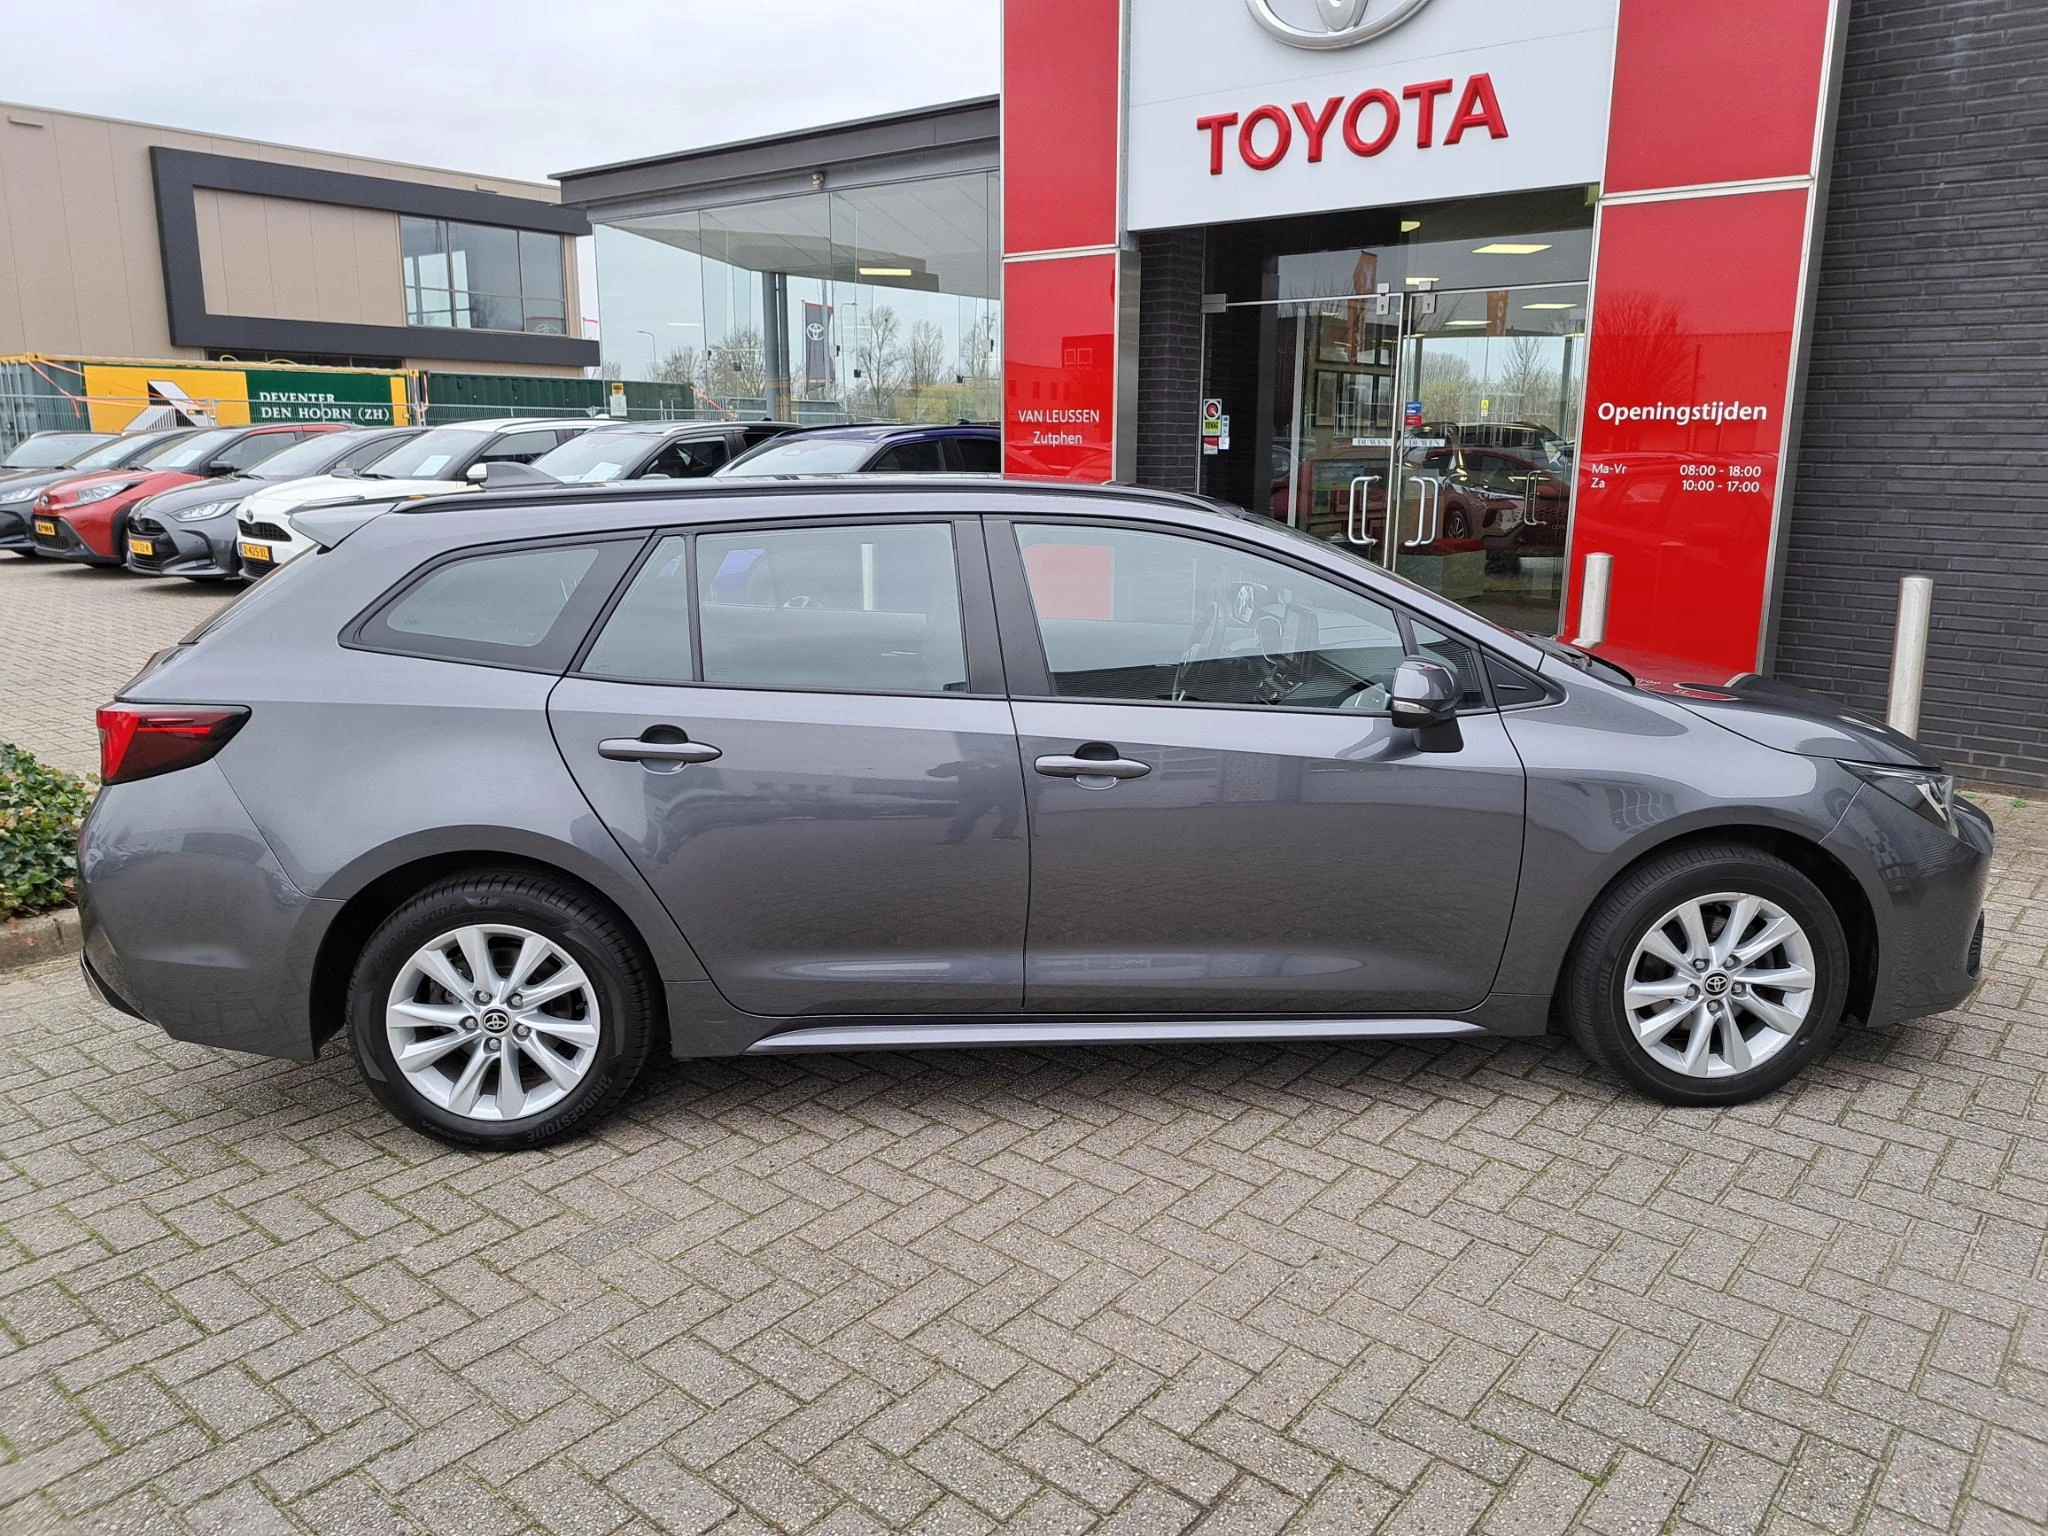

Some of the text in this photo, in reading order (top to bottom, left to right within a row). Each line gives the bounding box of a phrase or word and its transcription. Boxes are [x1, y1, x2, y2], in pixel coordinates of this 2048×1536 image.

[1197, 72, 1509, 176] TOYOTA
[259, 391, 335, 404] DEVENTER
[261, 406, 390, 422] DEN HOORN (ZH)
[1018, 409, 1100, 423] VAN LEUSSEN
[1598, 401, 1767, 426] Openingstijden
[1033, 431, 1082, 448] Zutphen
[1591, 463, 1627, 474] Ma-Vr
[1679, 465, 1716, 477] 08:00
[1728, 465, 1762, 477] 18:00
[1590, 478, 1606, 489] Za
[1682, 480, 1715, 492] 10:00
[1727, 481, 1760, 493] 17:00
